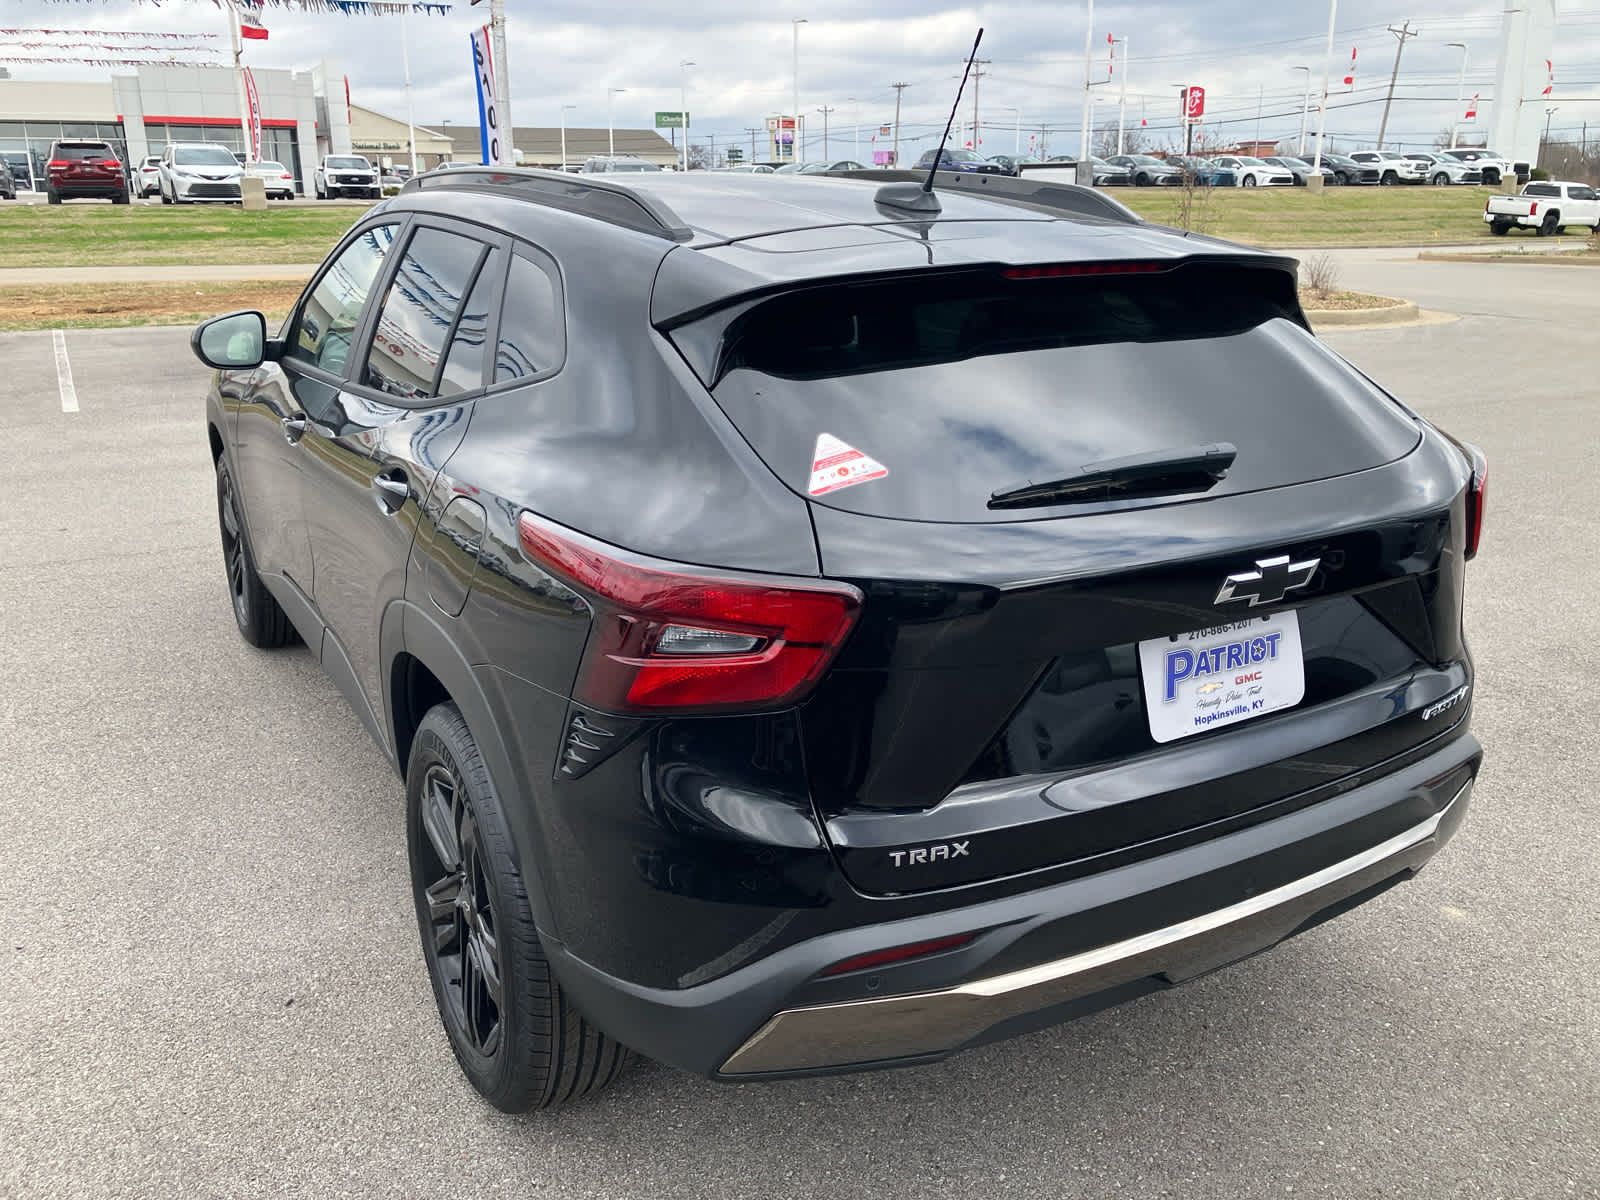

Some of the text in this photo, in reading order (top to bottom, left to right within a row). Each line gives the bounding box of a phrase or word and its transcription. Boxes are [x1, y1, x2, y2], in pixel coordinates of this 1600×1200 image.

[352, 141, 400, 150] National Bank
[1188, 620, 1252, 640] 270-886-1207
[1164, 631, 1282, 702] PATRIOT
[1234, 671, 1263, 686] GMC
[1194, 705, 1250, 726] Hopkinsville,
[1252, 698, 1265, 710] KY
[888, 840, 970, 868] TRAX
